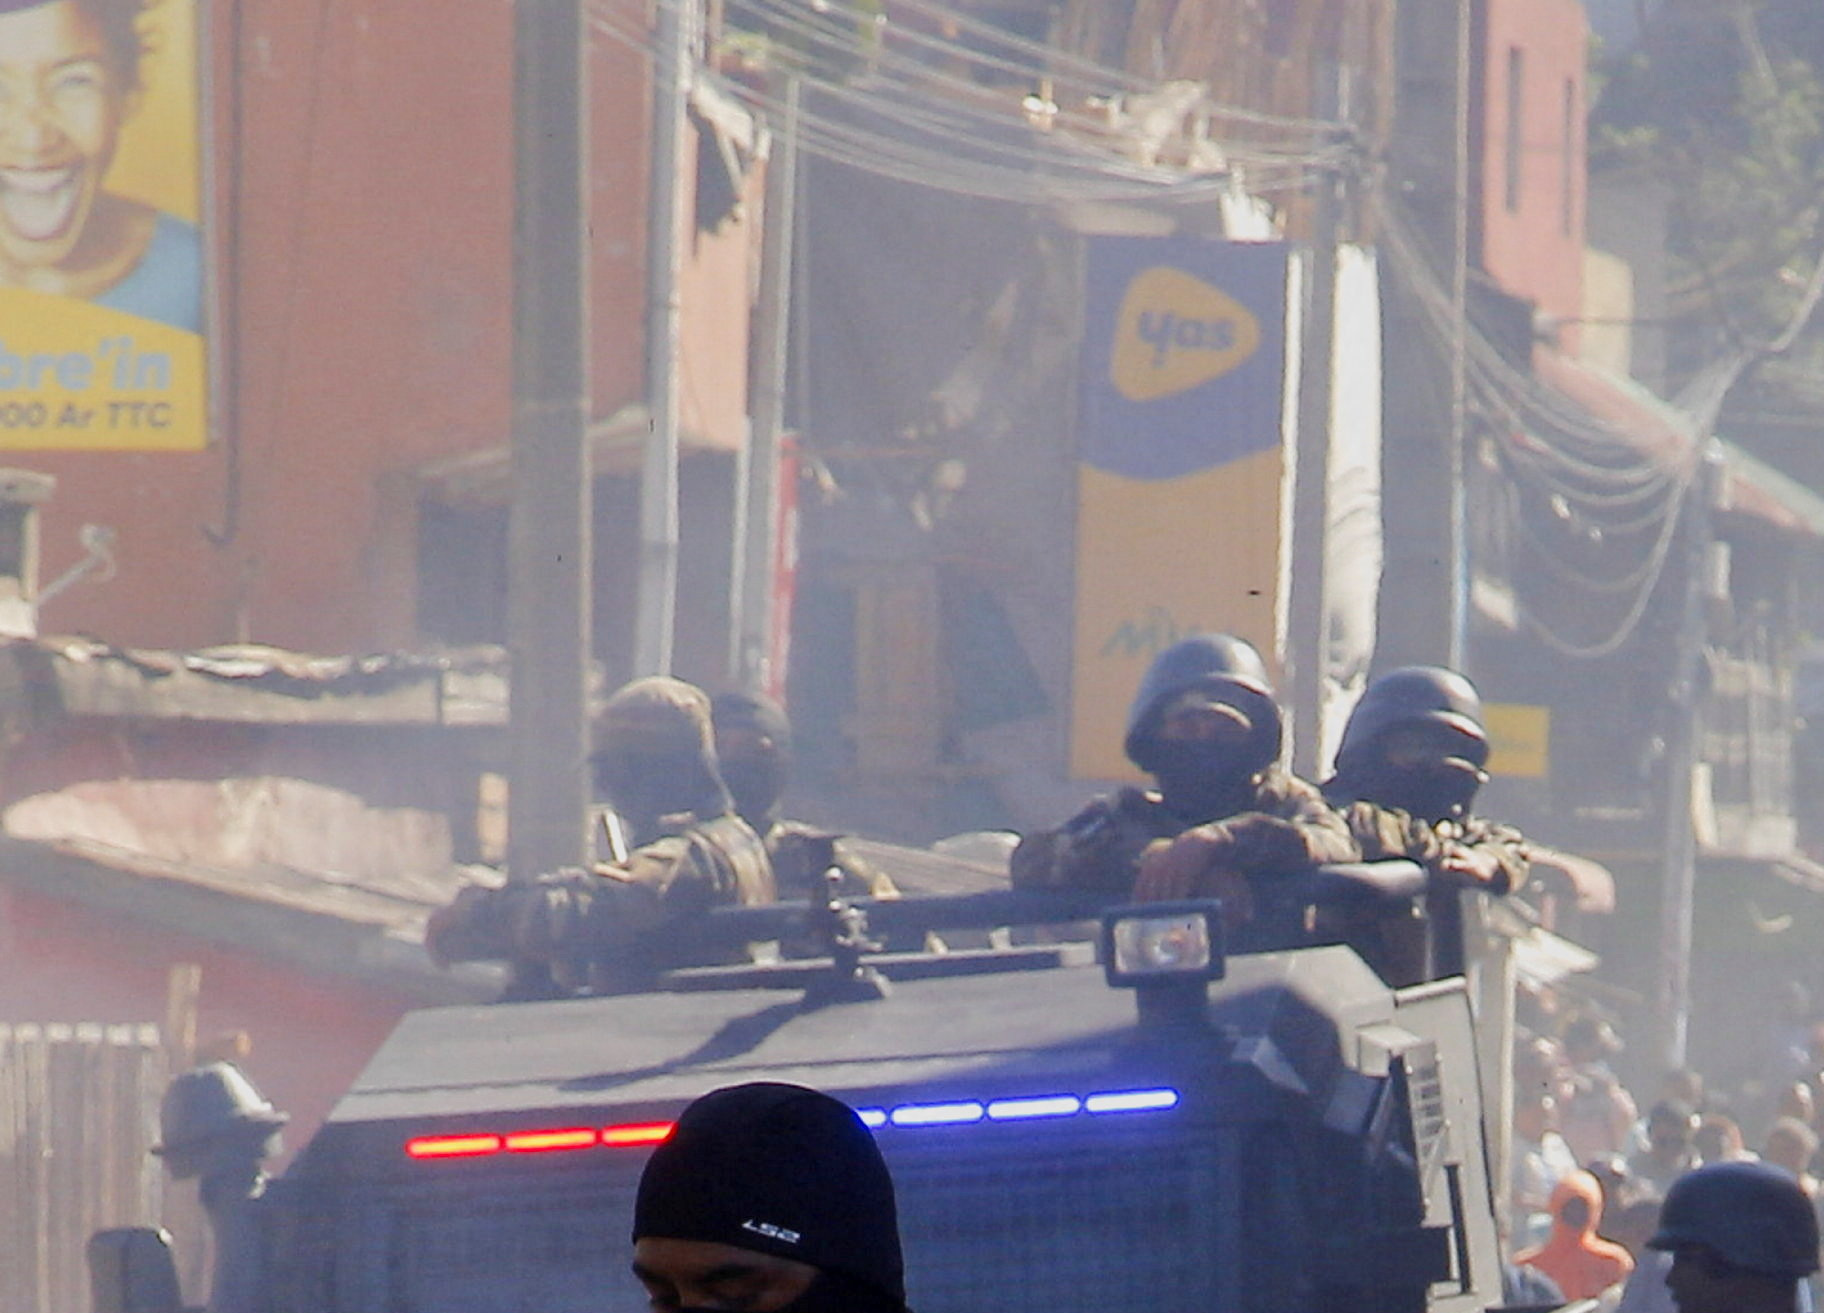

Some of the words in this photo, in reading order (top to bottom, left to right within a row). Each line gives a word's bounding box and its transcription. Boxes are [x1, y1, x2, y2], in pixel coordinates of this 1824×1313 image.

[1138, 310, 1236, 366] yas
[56, 402, 95, 429] Ar
[108, 401, 172, 429] TTC
